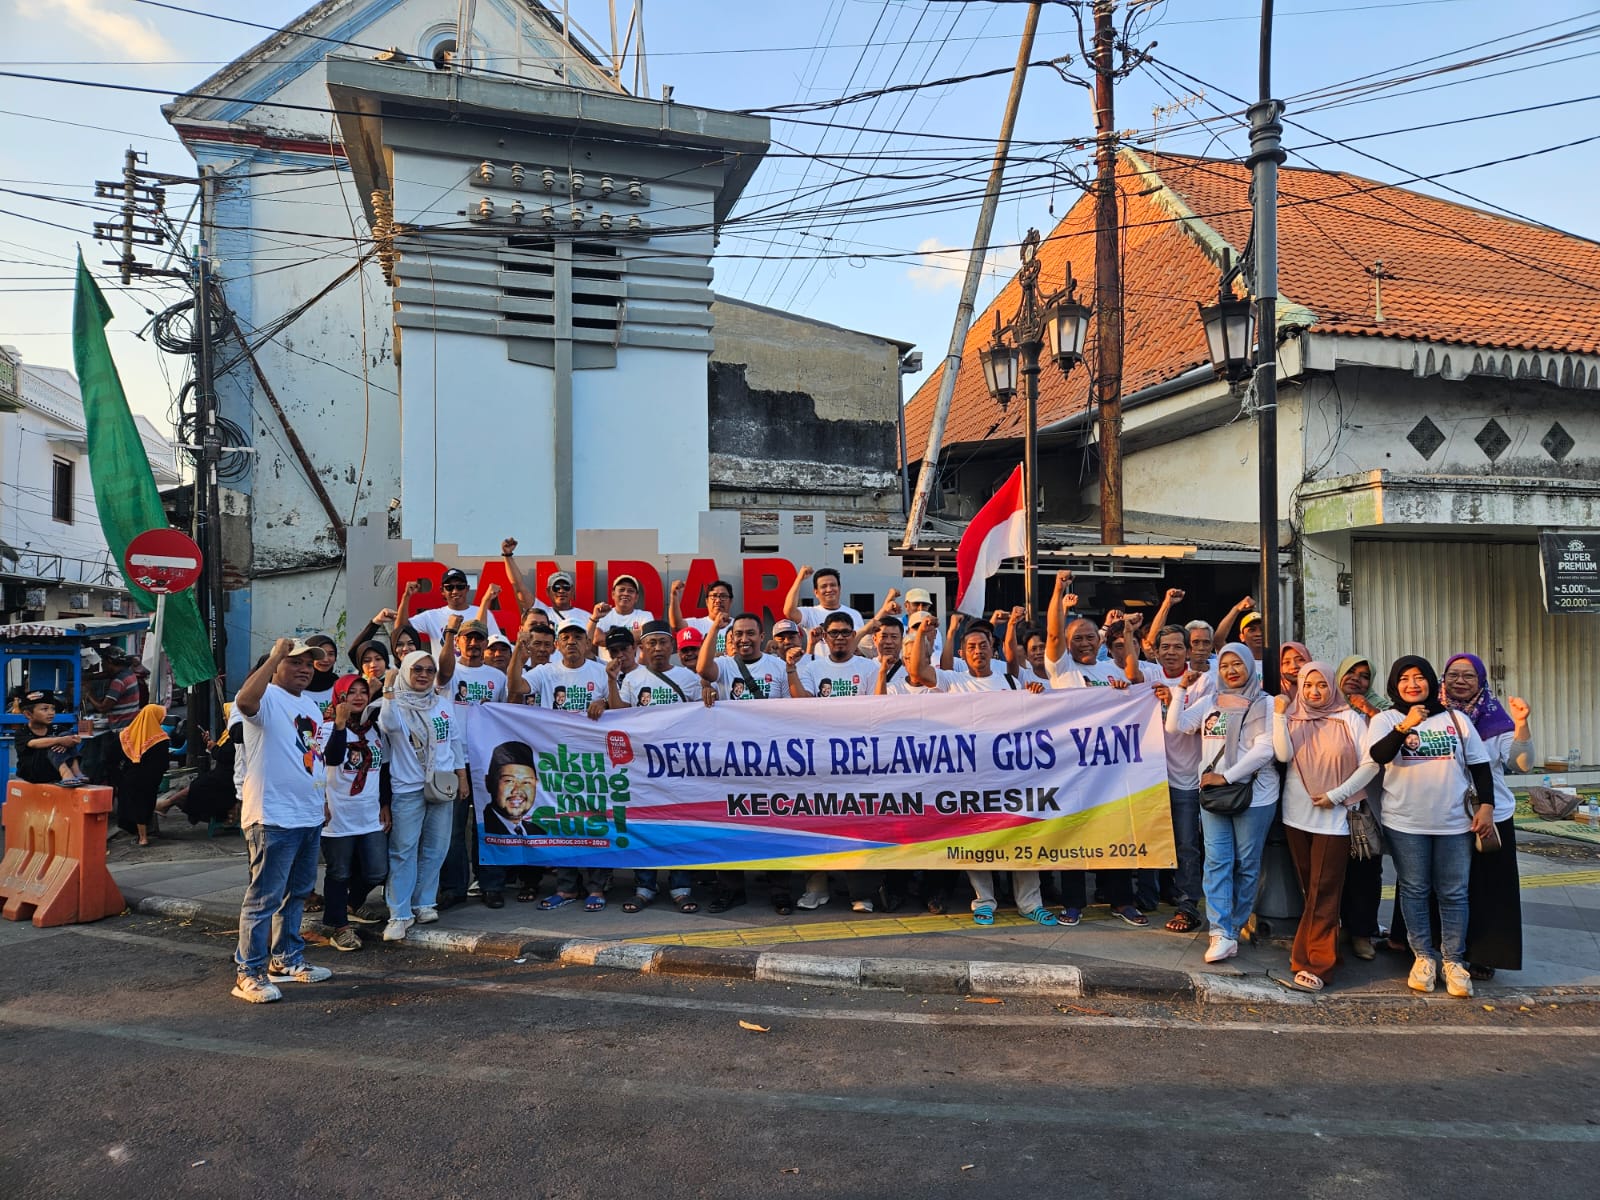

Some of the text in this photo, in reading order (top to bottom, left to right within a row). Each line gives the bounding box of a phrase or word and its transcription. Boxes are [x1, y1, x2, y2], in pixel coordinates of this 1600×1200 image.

[1558, 562, 1597, 570] PREMIUM
[1563, 553, 1591, 561] SUPER
[1561, 584, 1583, 593] 5.000
[1561, 598, 1588, 607] 20.000
[538, 743, 605, 773] aku
[643, 723, 1143, 779] DEKLARASI RELAWAN GUS YANI
[539, 767, 631, 802] wong
[556, 794, 607, 813] mu
[727, 786, 1061, 817] KECAMATAN GRESIK
[531, 806, 630, 849] Gus!
[946, 843, 1148, 863] Minggu, 25 Agustus 2024
